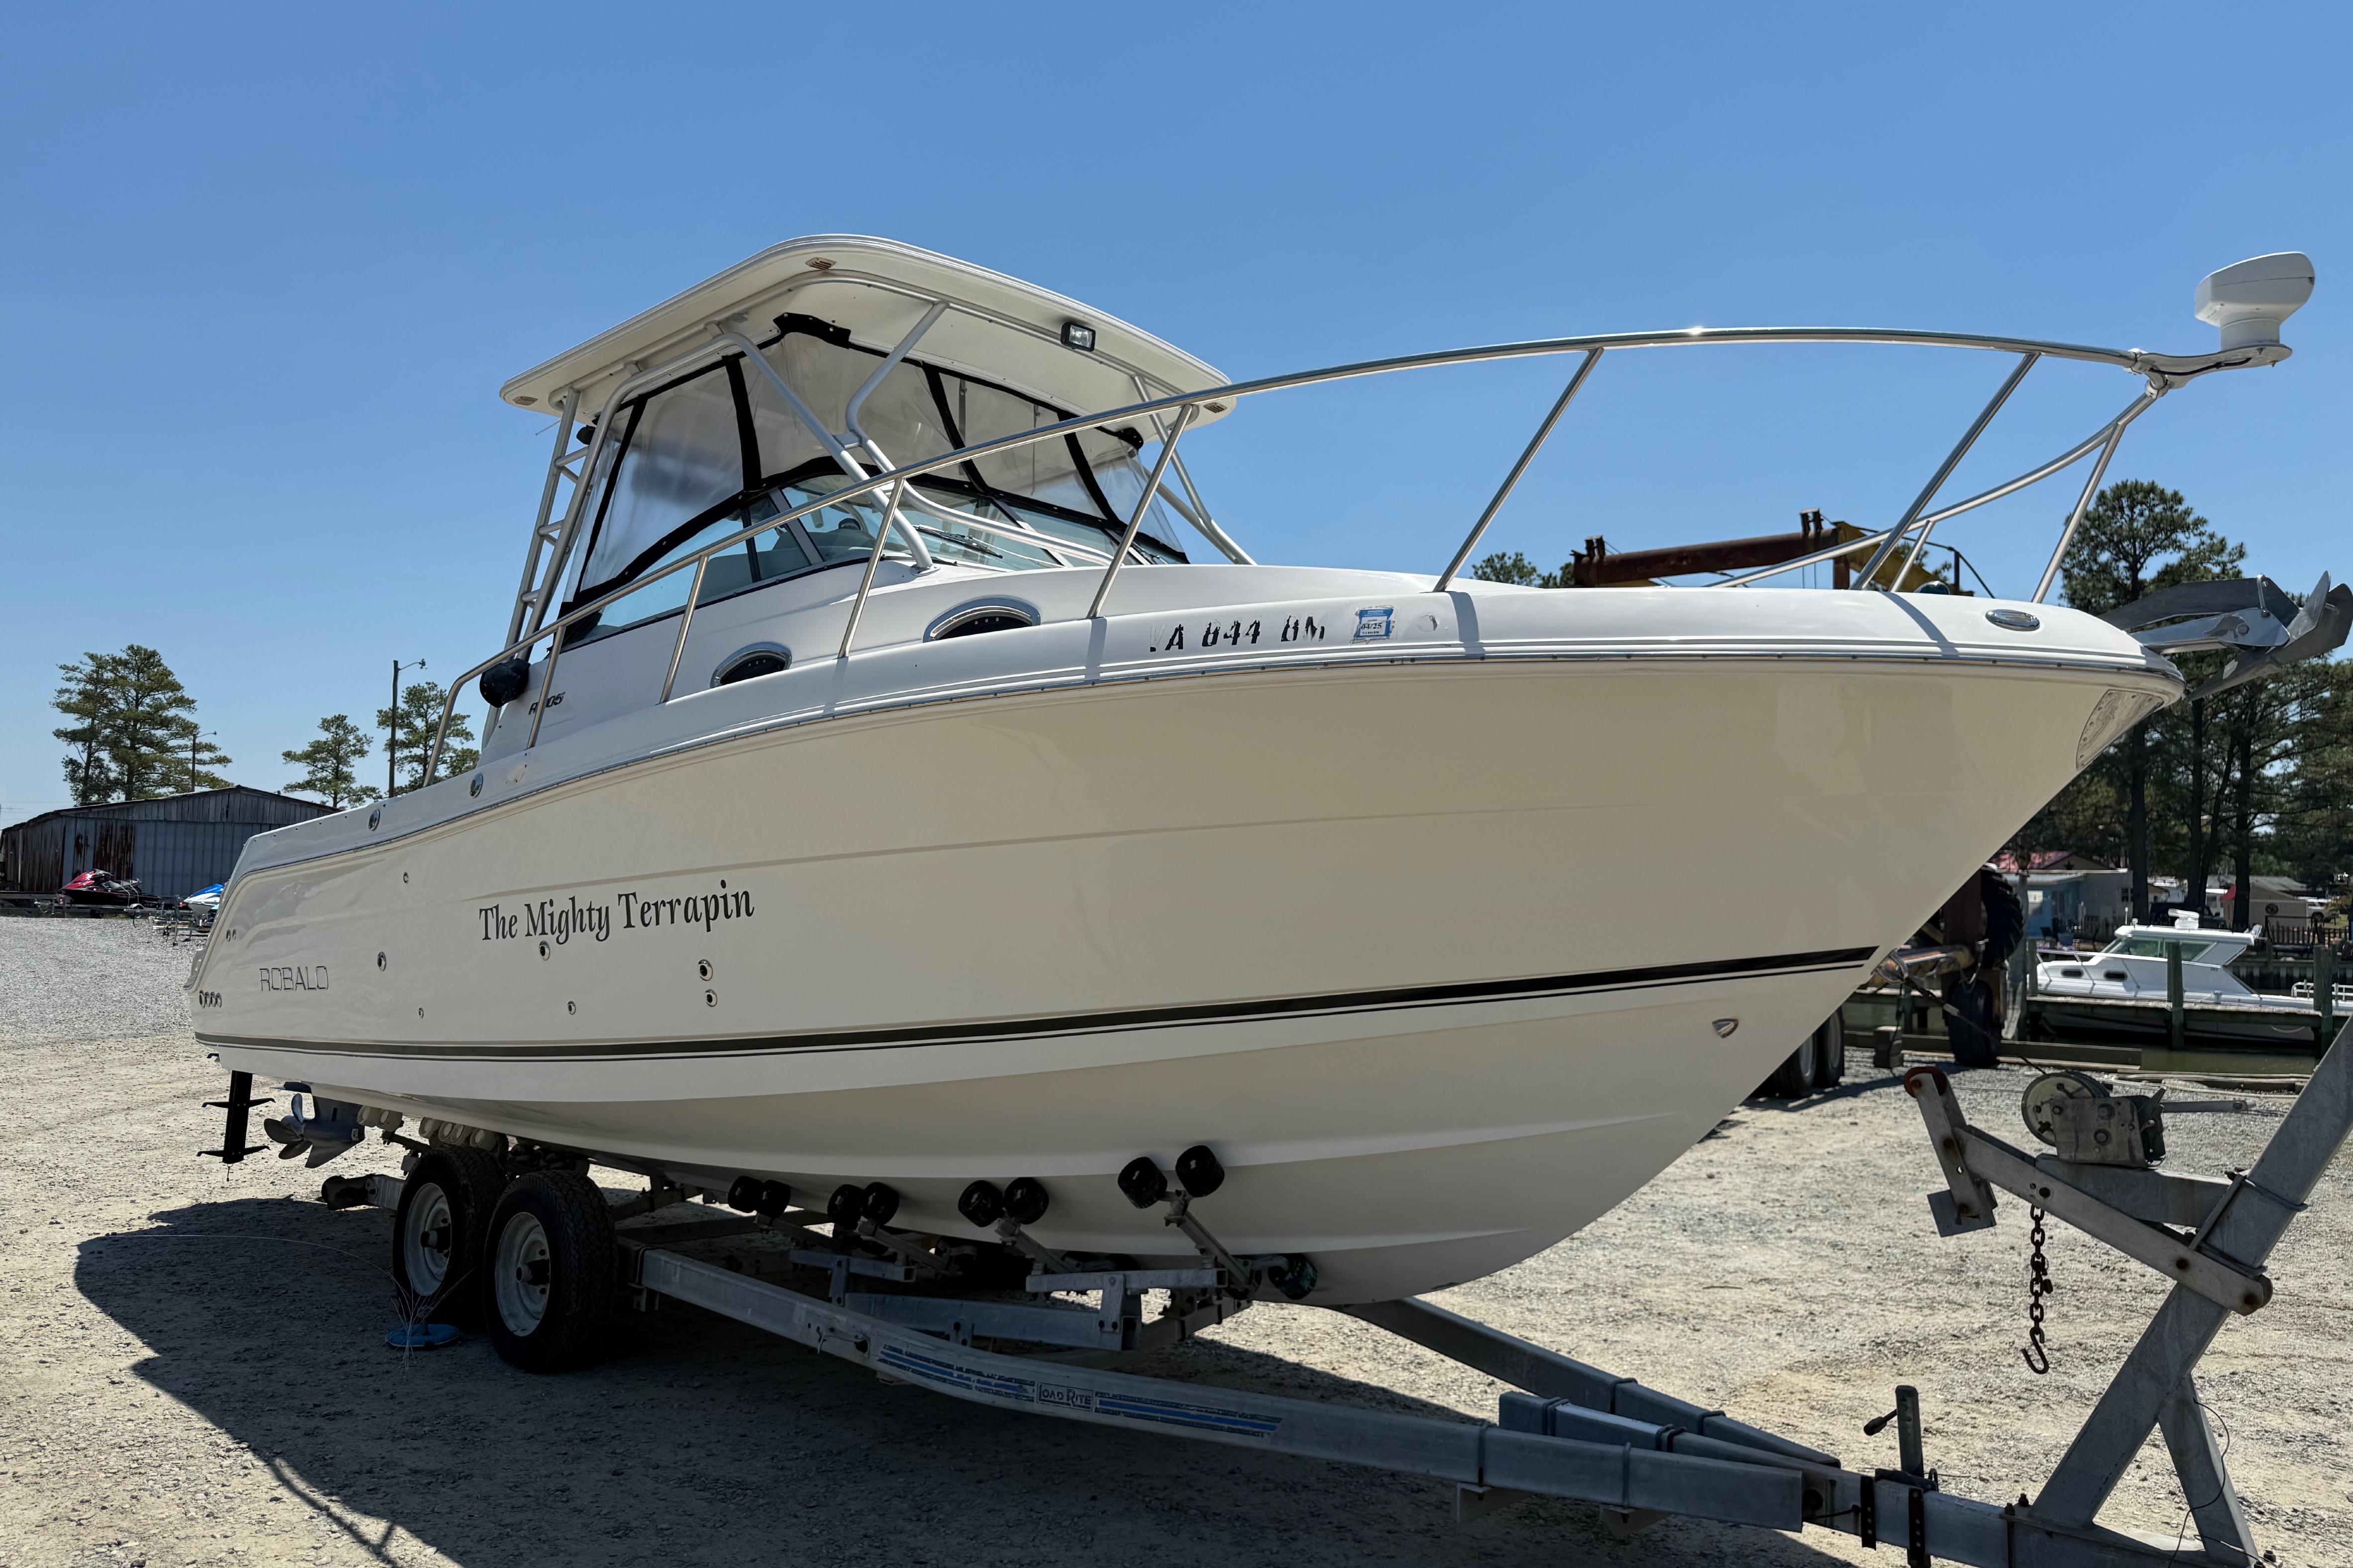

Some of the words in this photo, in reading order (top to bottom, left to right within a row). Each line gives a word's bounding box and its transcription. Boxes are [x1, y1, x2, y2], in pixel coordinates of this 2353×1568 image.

[1361, 622, 1382, 630] 04/25
[528, 691, 565, 715] R05
[479, 904, 517, 941] The
[524, 895, 610, 945] Mighty
[617, 879, 754, 932] Terrapin
[259, 966, 328, 991] ROBALO
